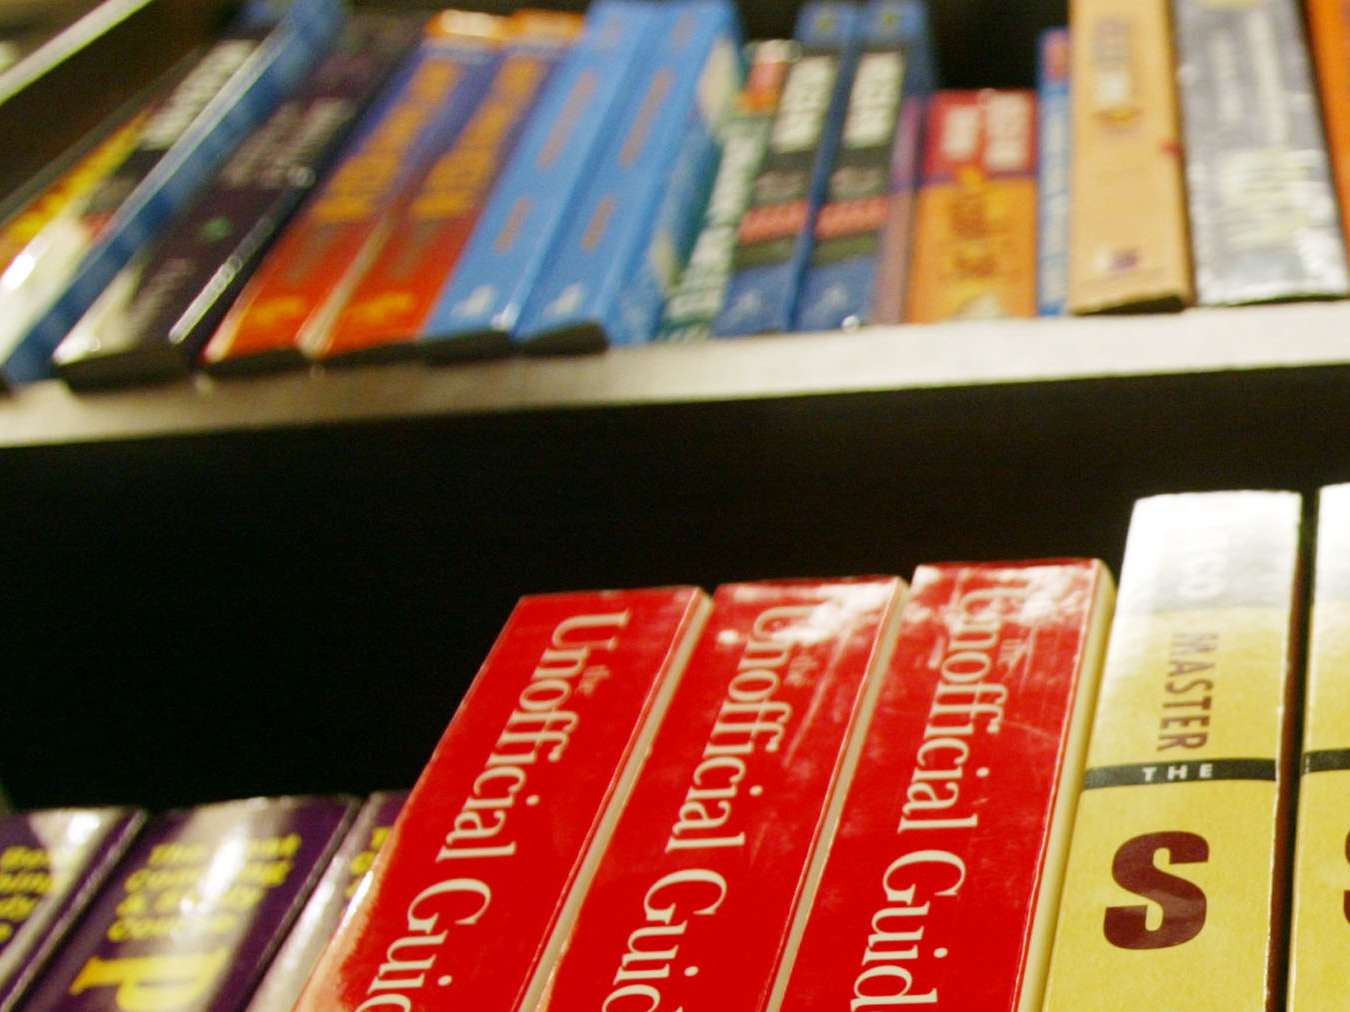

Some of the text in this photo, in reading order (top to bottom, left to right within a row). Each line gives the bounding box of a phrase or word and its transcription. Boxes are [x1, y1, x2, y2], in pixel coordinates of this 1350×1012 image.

[436, 606, 631, 862] Unofficial
[666, 604, 828, 853] Unofficial
[1141, 762, 1214, 783] THE
[1157, 632, 1217, 753] MASTER
